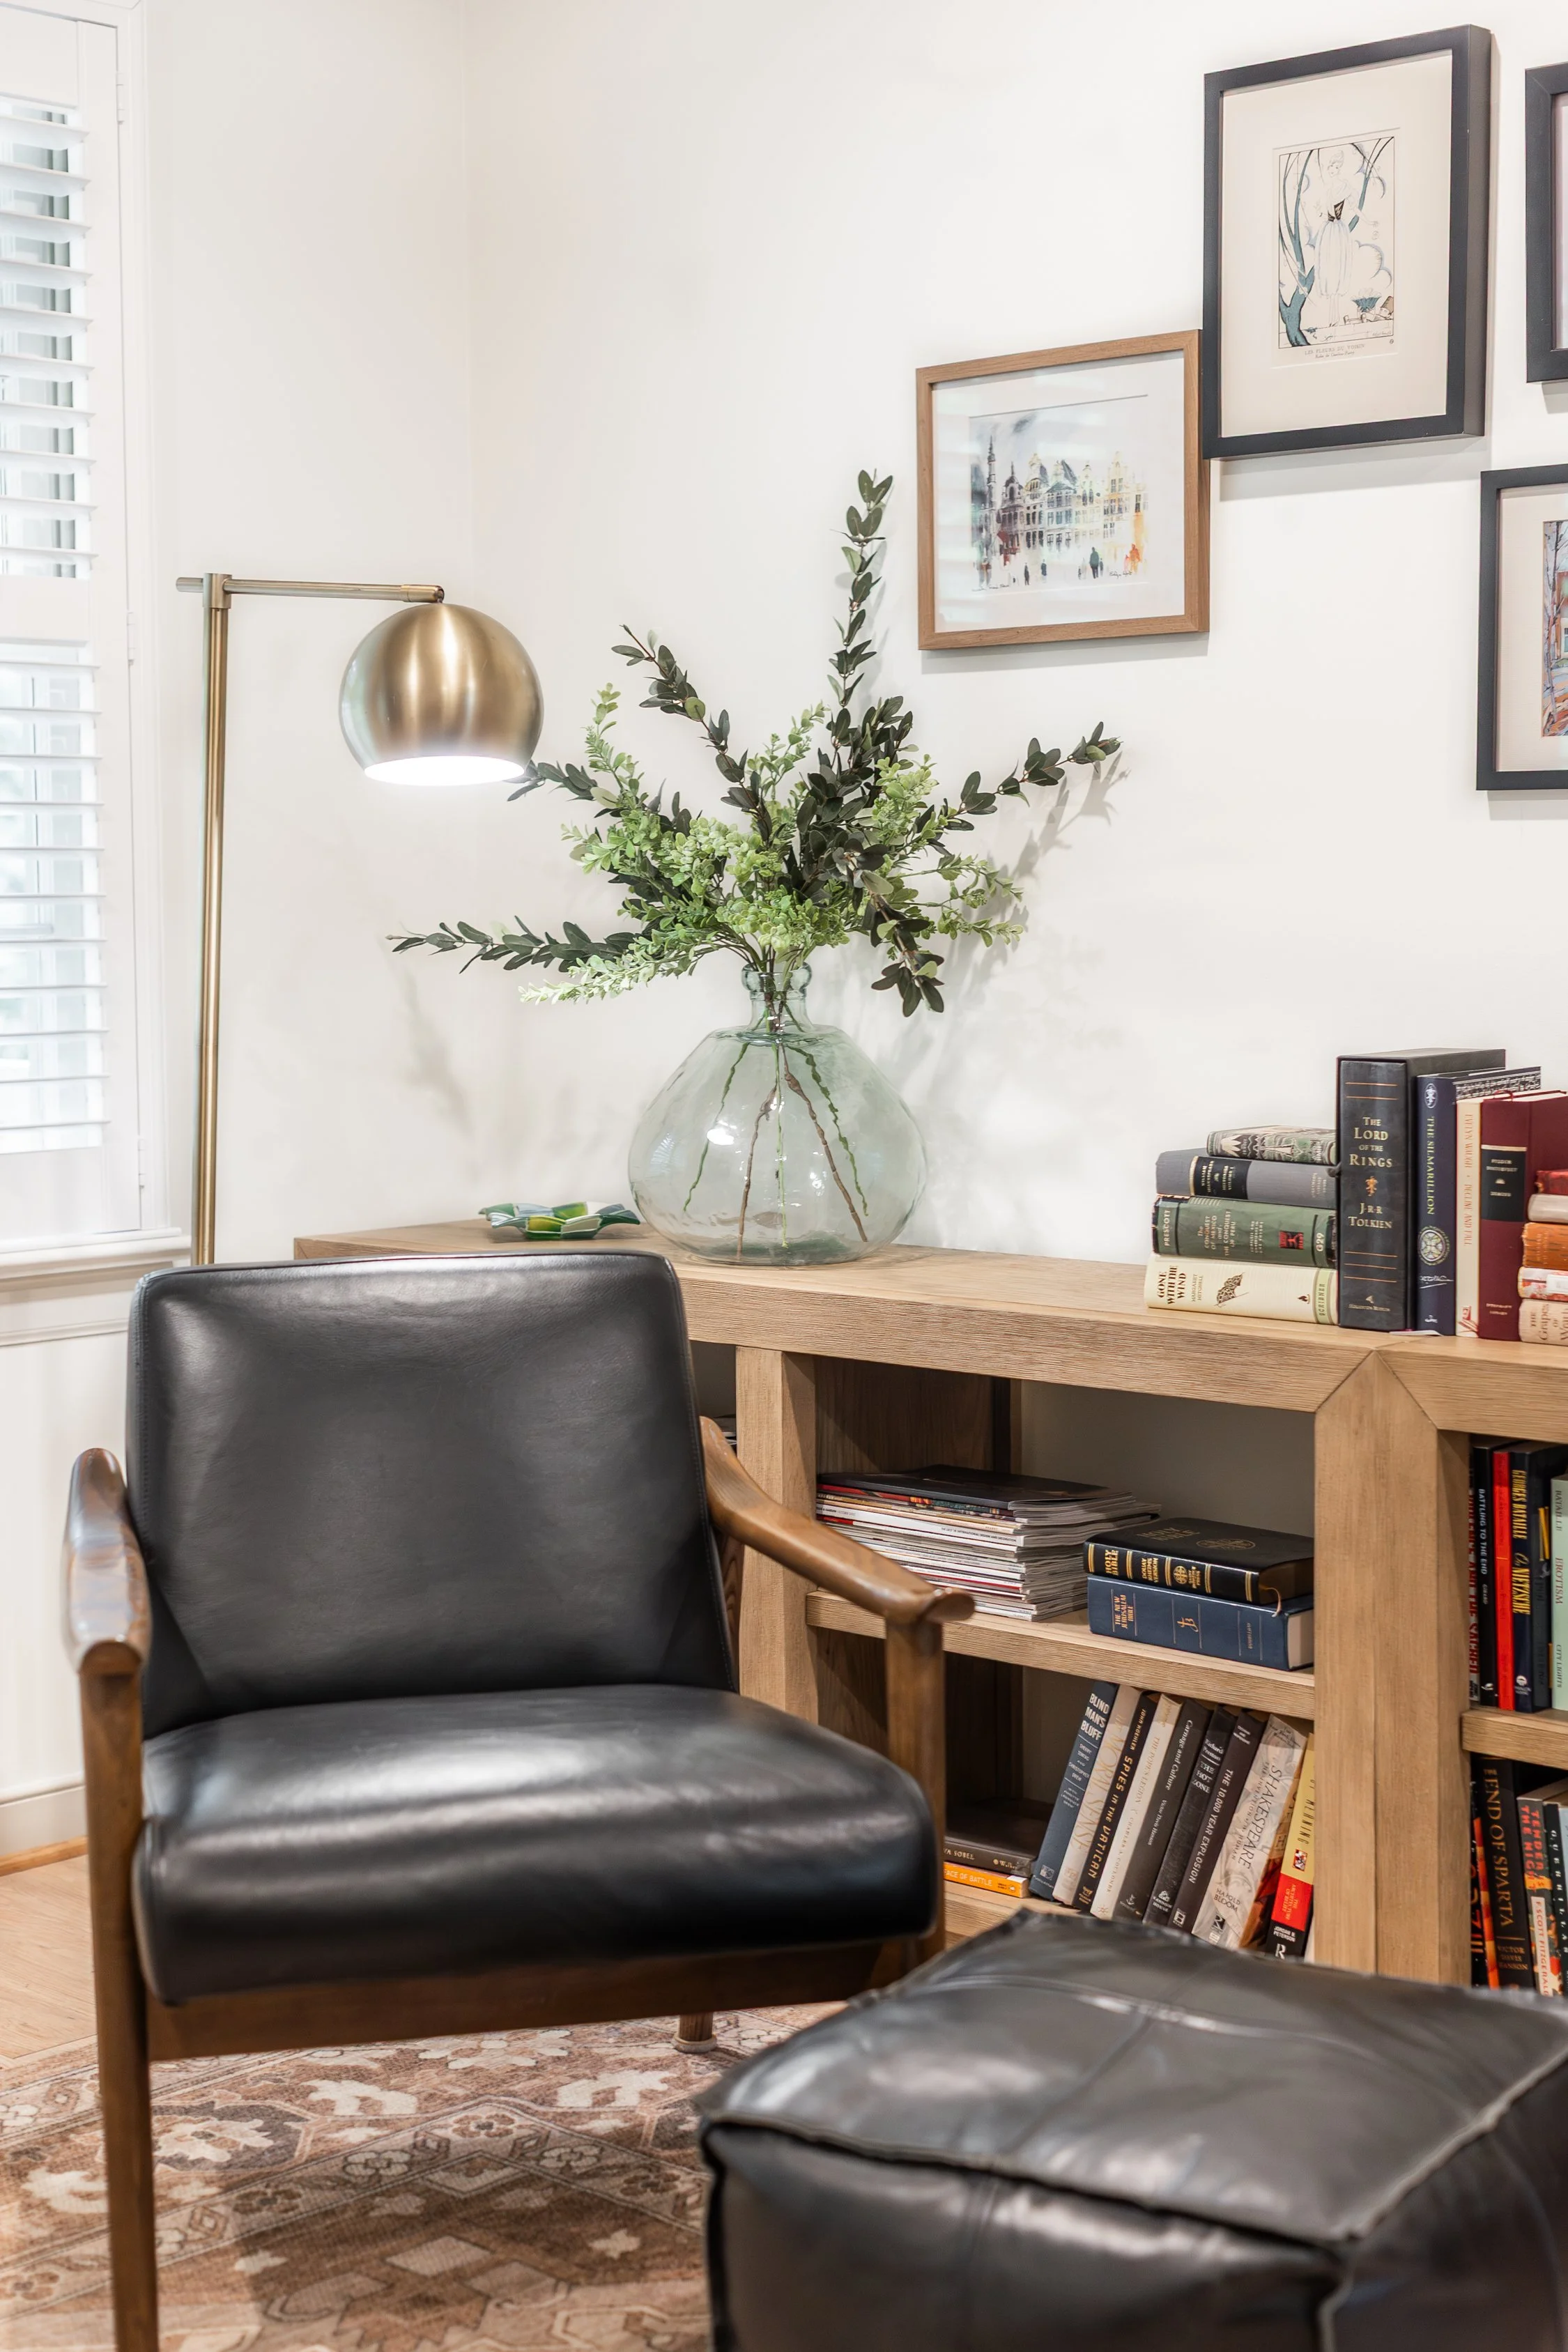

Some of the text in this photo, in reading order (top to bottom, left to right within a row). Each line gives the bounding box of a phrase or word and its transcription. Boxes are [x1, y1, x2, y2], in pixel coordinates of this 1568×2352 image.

[1353, 1127, 1389, 1141] LORD
[1464, 1114, 1473, 1139] EVELYN
[1349, 1153, 1393, 1168] RINGS
[1427, 1116, 1435, 1215] THE SILMARILLION
[1464, 1143, 1473, 1168] WAUGH
[1347, 1216, 1393, 1229] TOLKIEN
[1210, 1241, 1216, 1250] OF
[1157, 1272, 1167, 1298] GONE
[1167, 1266, 1178, 1304] WITH THE
[1177, 1273, 1186, 1299] WIND
[1539, 1304, 1549, 1341] Grapes
[1478, 1489, 1486, 1526] BATTLING
[1512, 1470, 1528, 1539] GEORGES BATAILLE
[1479, 1530, 1487, 1539] TO
[1512, 1567, 1530, 1615] NIETZSCHE
[1555, 1558, 1564, 1604] EROTISM
[1089, 1693, 1109, 1714] BLIND
[1085, 1707, 1106, 1728] MAN'S
[1130, 1708, 1147, 1751] JOHN KOEHLER
[1081, 1721, 1102, 1741] BLUFF
[1151, 1737, 1160, 1750] THE
[1165, 1719, 1194, 1790] Carnage and Culture
[1203, 1746, 1221, 1761] Preston
[1205, 1739, 1224, 1754] Richard
[1068, 1762, 1089, 1778] CHRISTOPHER
[1087, 1731, 1125, 1794] MORAL
[1201, 1761, 1215, 1774] THE
[1072, 1772, 1082, 1781] DREW
[1197, 1770, 1213, 1783] HOT
[1134, 1776, 1148, 1804] LEGION
[1247, 1778, 1263, 1816] INVENTION
[1070, 1793, 1105, 1854] SENSE
[1086, 1755, 1134, 1879] SPIES IN THE VATICAN
[1147, 1799, 1167, 1846] Victor Davis Hanson
[1188, 1769, 1233, 1884] THE 10,000 YEAR EXPLOSION
[1237, 1765, 1284, 1869] SHAKESPEARE
[1120, 1817, 1134, 1848] CHARLES
[1531, 1810, 1544, 1870] TENDER
[954, 1851, 975, 1860] SOBEL
[1231, 1834, 1243, 1860] HUMAN
[1484, 1779, 1514, 1927] END OF SPARTA
[1521, 1806, 1537, 1893] THE NIGHT
[969, 1875, 992, 1886] BATTLE
[1106, 1857, 1121, 1893] COULOMBE
[1214, 1894, 1238, 1912] BLOOM
[1273, 1930, 1296, 1942] PETERSON
[1274, 1926, 1291, 1935] JORDAN
